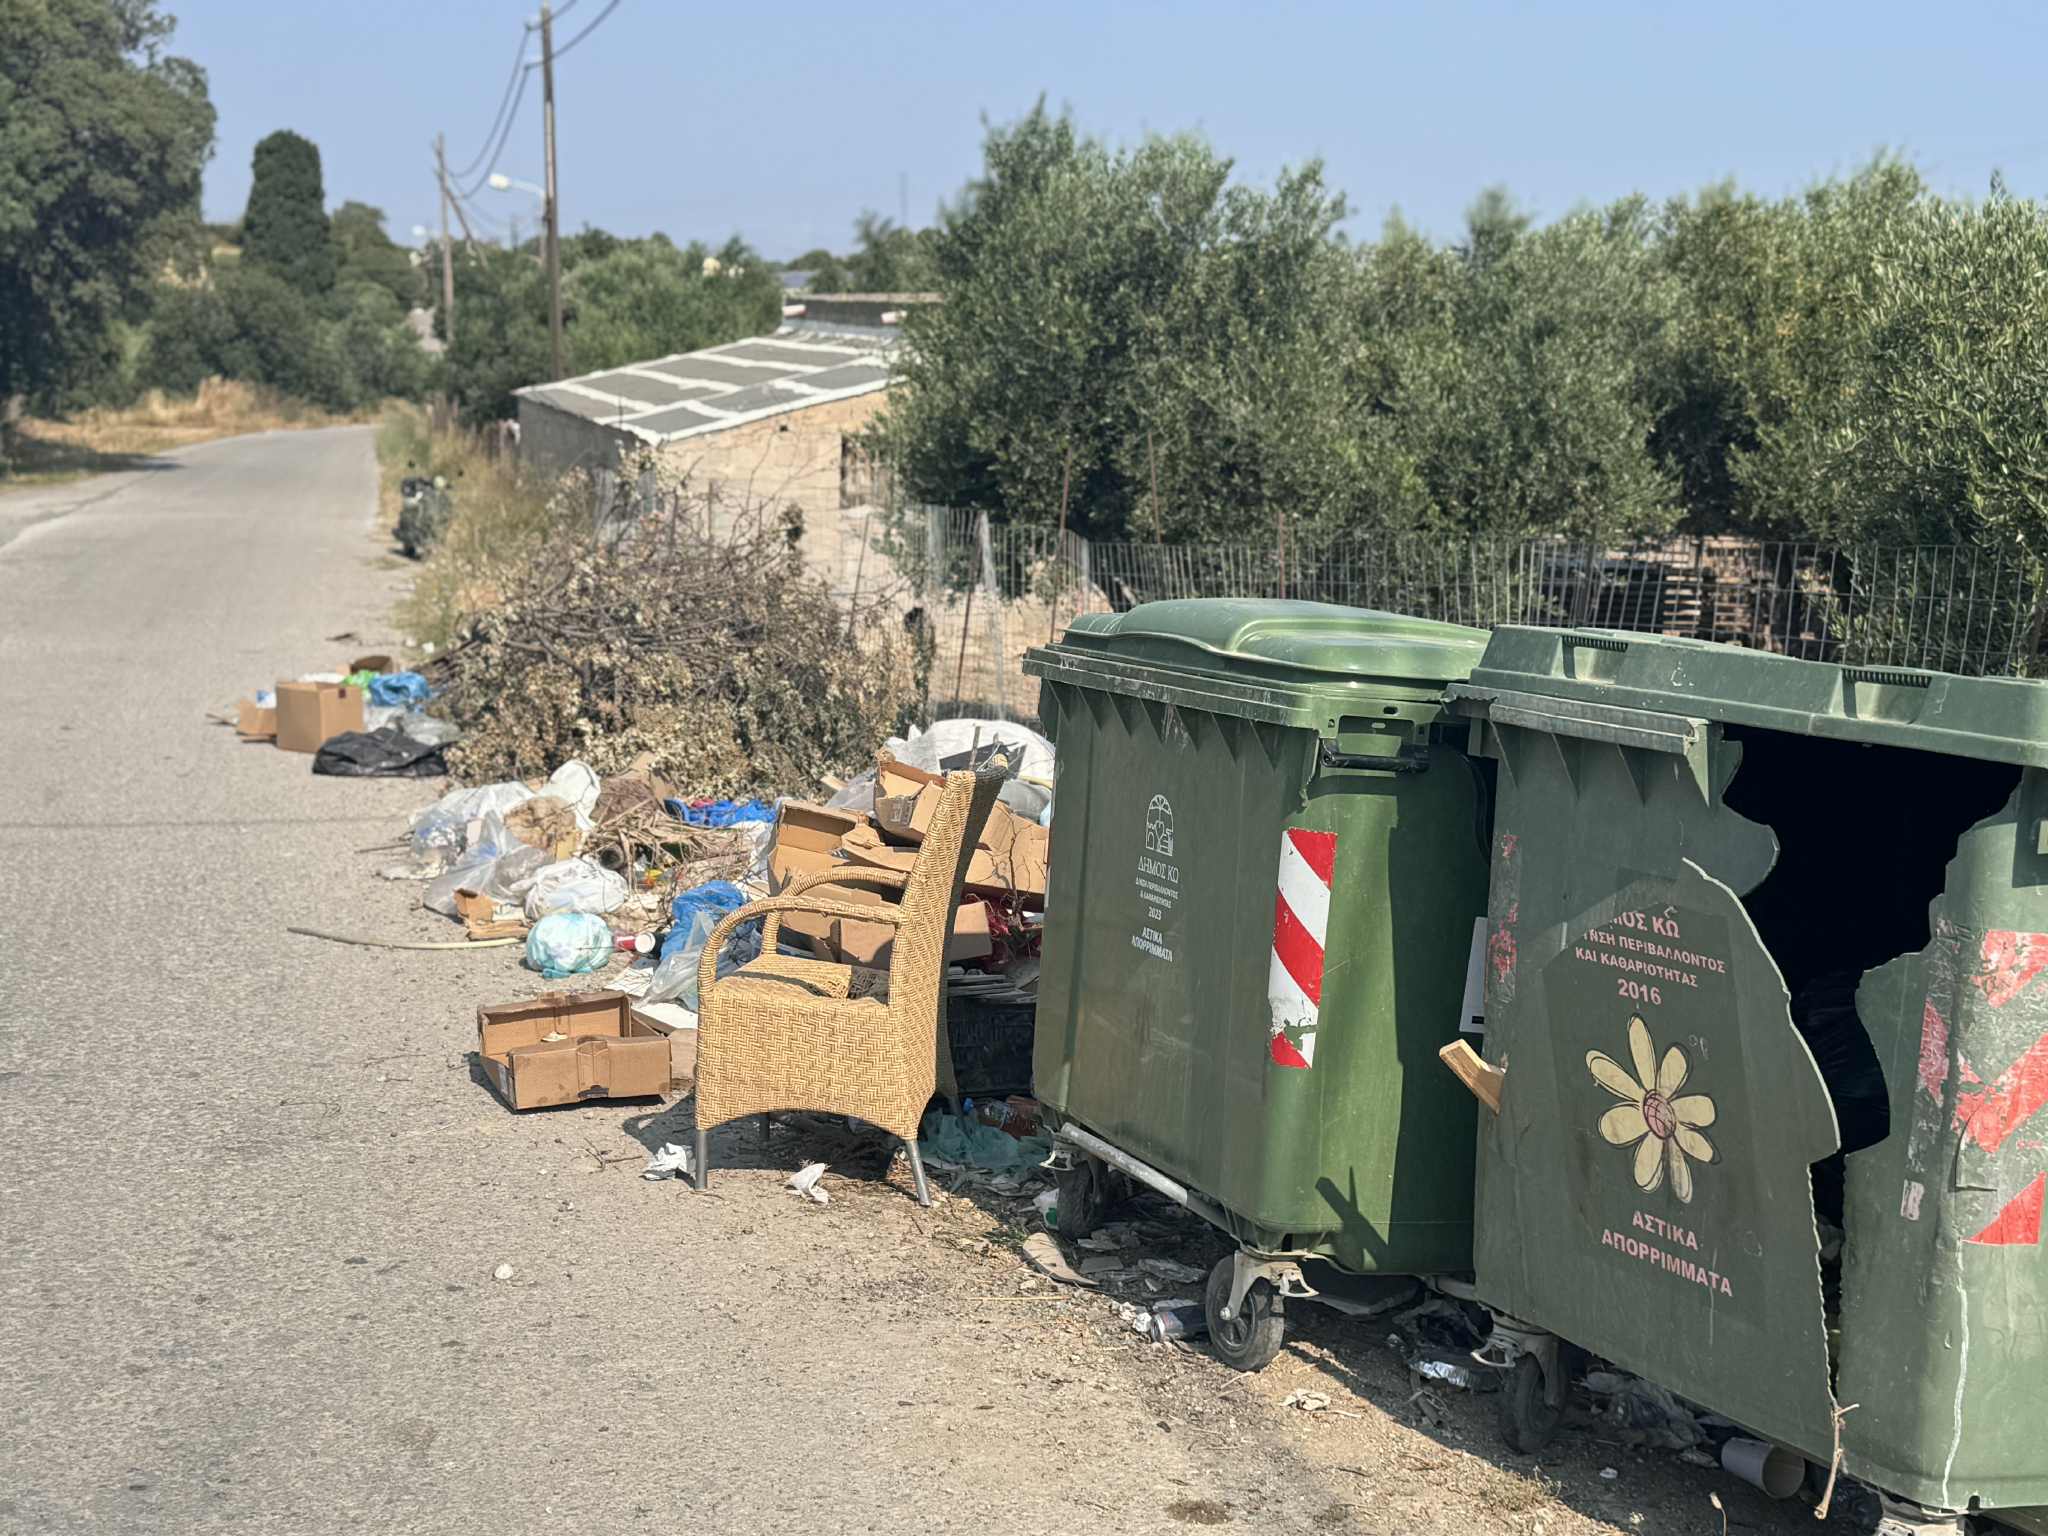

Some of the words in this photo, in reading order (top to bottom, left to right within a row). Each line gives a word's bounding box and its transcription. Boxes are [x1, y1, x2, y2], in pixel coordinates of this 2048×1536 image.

[1138, 855, 1166, 880] ΔΗΜΟΣ
[1167, 865, 1179, 884] ΚΩ
[1148, 906, 1162, 920] 2023
[1652, 916, 1680, 938] ΚΩ
[1575, 947, 1597, 962] ΚΑΙ
[1601, 952, 1698, 988] ΚΑΘΑΡΙΟΤΗΤΑΣ
[1583, 928, 1616, 946] ΝΣΗ
[1619, 936, 1726, 974] ΠΕΡΙΒΑΛΛΟΝΤΟΣ
[1617, 978, 1662, 1005] 2016
[1632, 1210, 1698, 1251] ΑΣΤΙΚΑ
[1601, 1229, 1733, 1297] ΑΠΟΡΡΙΜΜΑΤΑ
